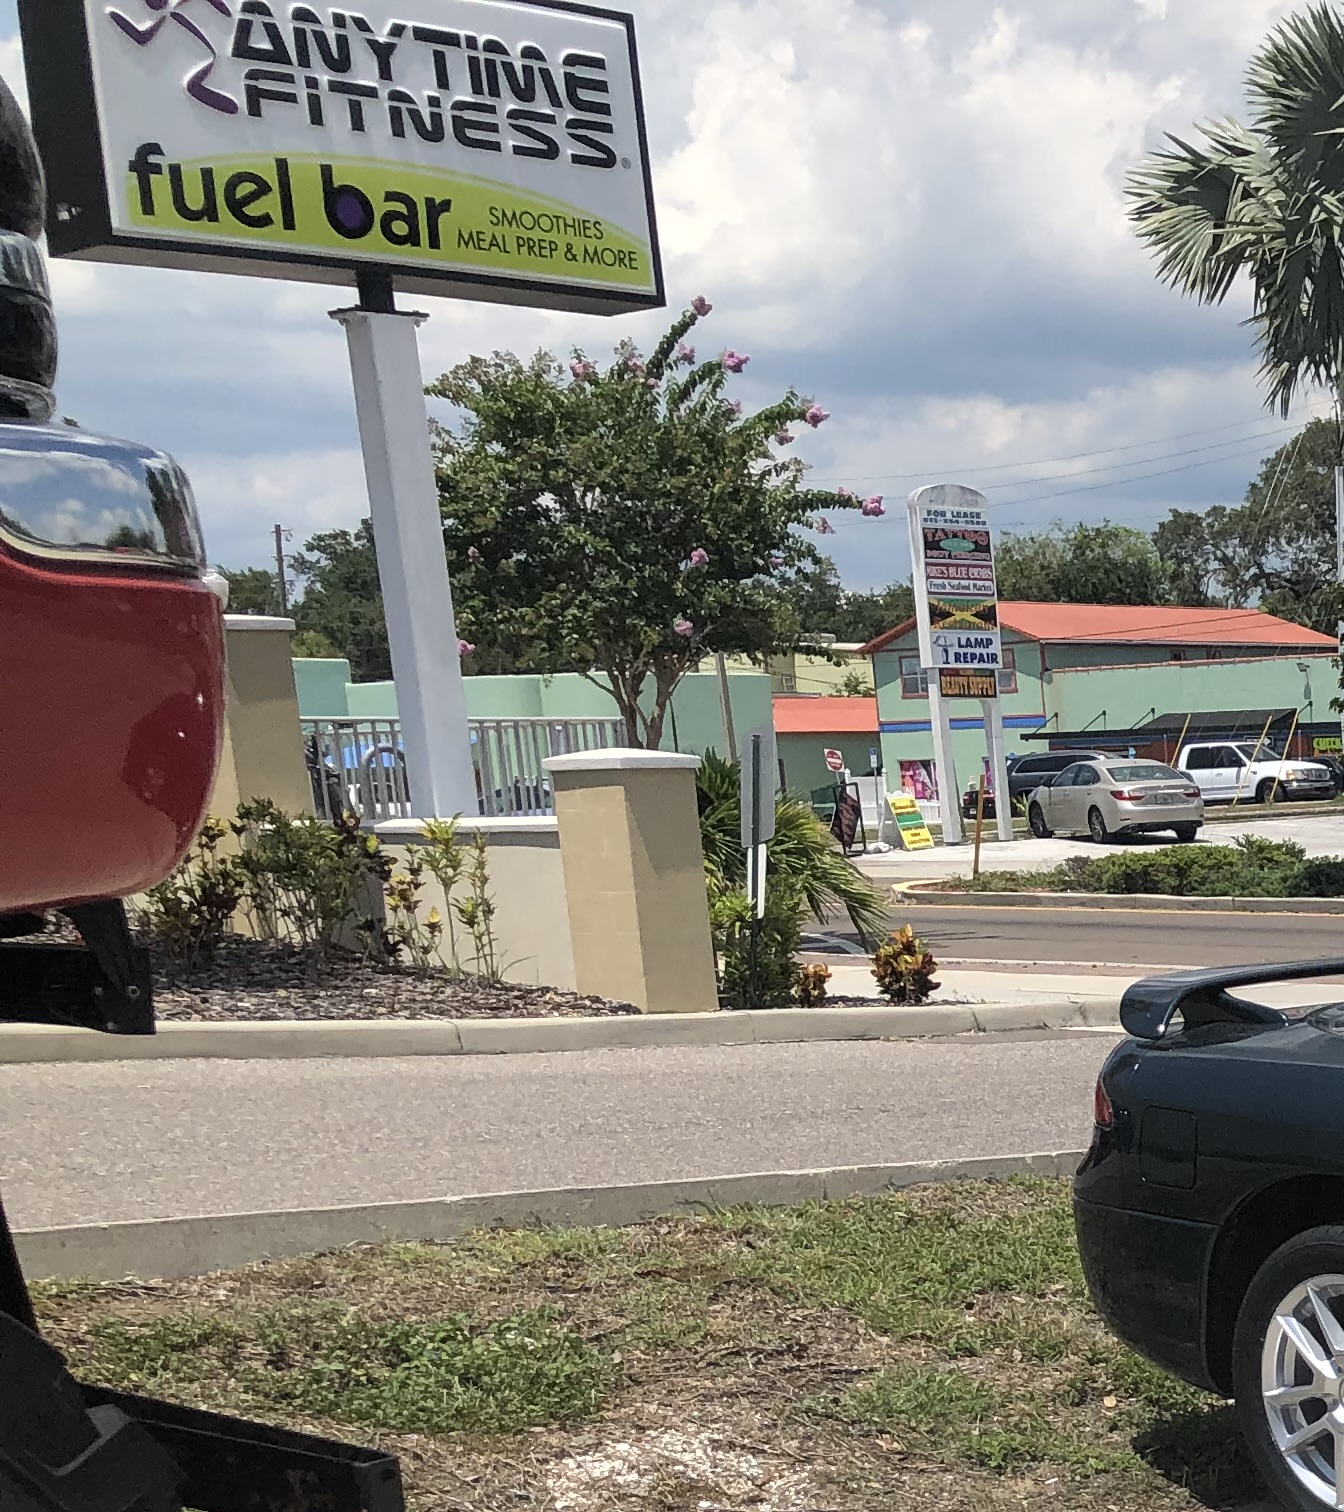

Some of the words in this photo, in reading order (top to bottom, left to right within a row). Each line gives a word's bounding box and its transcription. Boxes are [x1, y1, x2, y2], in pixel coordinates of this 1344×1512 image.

[230, 0, 610, 116] ANYTIME
[240, 67, 617, 169] FITNESS
[128, 142, 296, 231] fuel
[319, 163, 452, 251] bar
[488, 205, 604, 241] SMOOTHIES
[457, 228, 511, 254] MEAL
[516, 235, 559, 260] PREP
[563, 242, 579, 263] &
[582, 243, 639, 271] MORE
[926, 509, 947, 518] FOR
[950, 511, 982, 520] LEASE
[923, 527, 989, 546] TATTOO
[948, 566, 968, 579] BLUE
[929, 580, 947, 591] Fresh
[957, 637, 994, 649] LAMP
[953, 651, 999, 664] REPAIR
